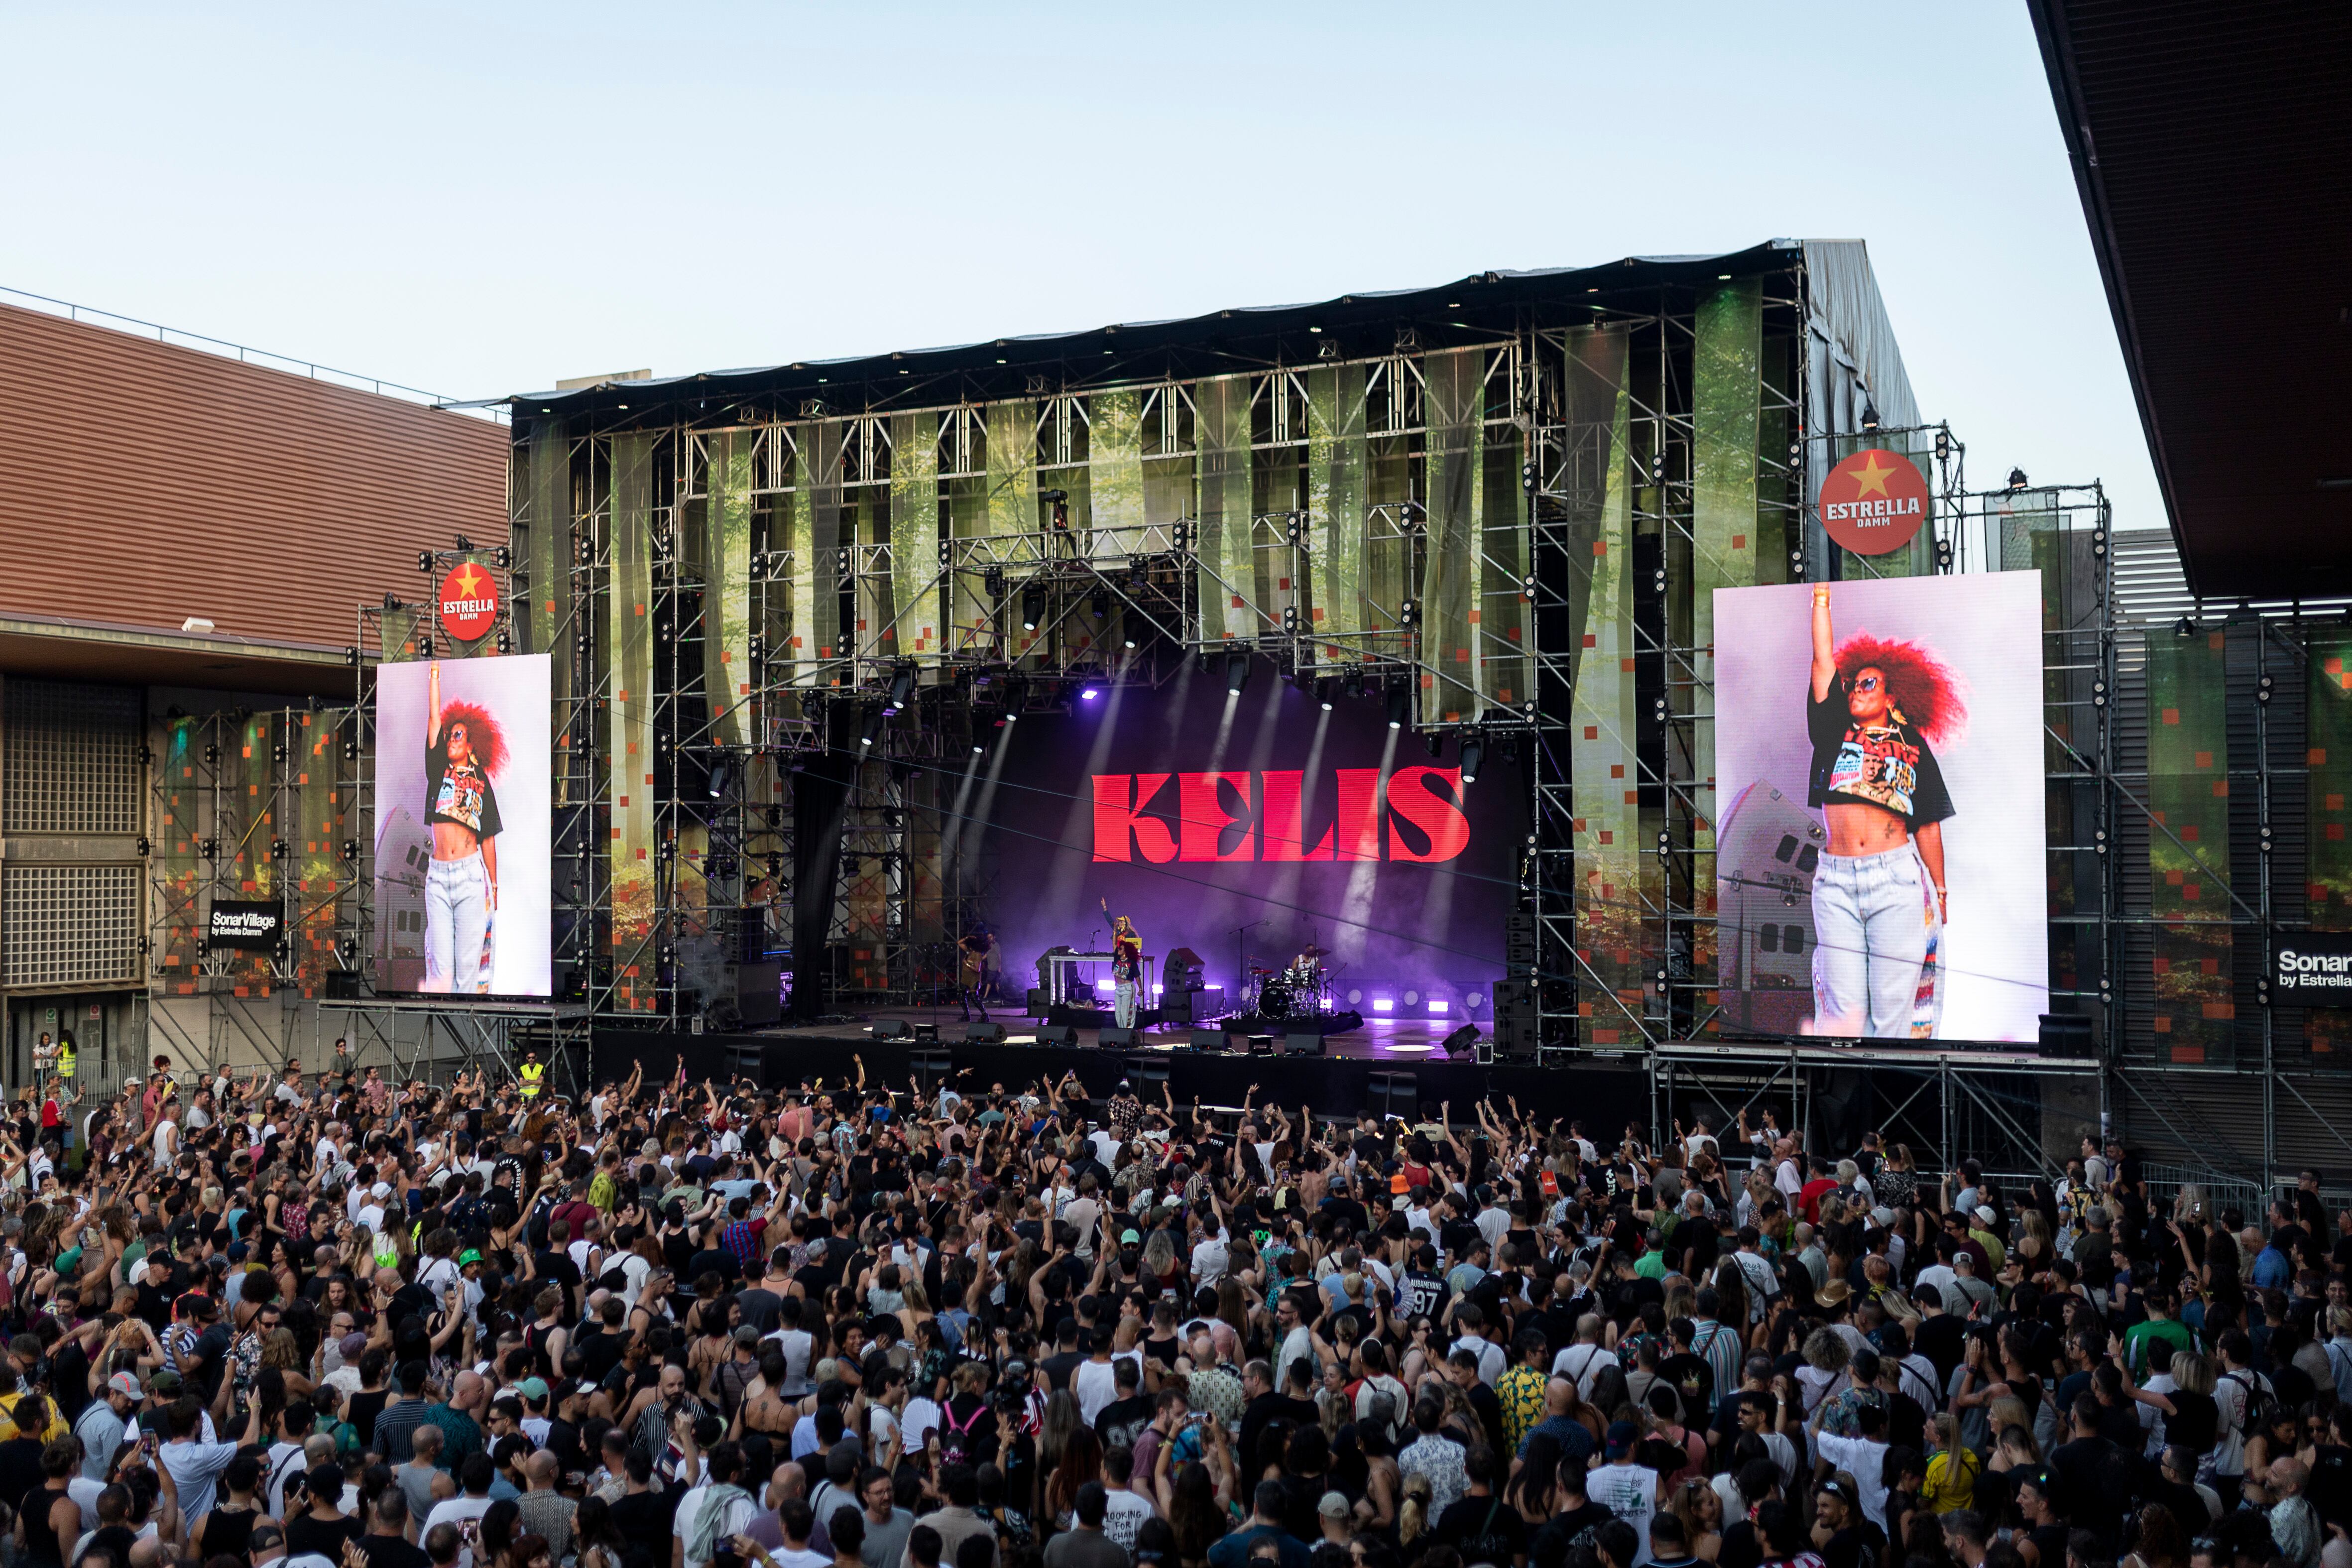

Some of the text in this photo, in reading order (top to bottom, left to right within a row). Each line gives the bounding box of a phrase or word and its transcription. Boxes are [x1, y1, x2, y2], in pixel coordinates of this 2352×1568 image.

[1826, 497, 1920, 520] ESTRELLA
[1857, 517, 1890, 528] DAMM
[443, 599, 494, 614] ESTRELLA
[1092, 765, 1470, 863] KELIS
[213, 912, 276, 930] SonarVillage
[211, 926, 262, 936] by Estrella Damm
[2279, 951, 2352, 972] Sonar
[2279, 973, 2352, 988] by Estrella
[499, 1158, 513, 1167] THAT
[513, 1160, 522, 1188] PURSUES
[1411, 1278, 1442, 1291] AUBAMEYANG
[1414, 1290, 1438, 1316] 97
[1106, 1510, 1142, 1523] LOOKING
[1115, 1521, 1131, 1531] FOR
